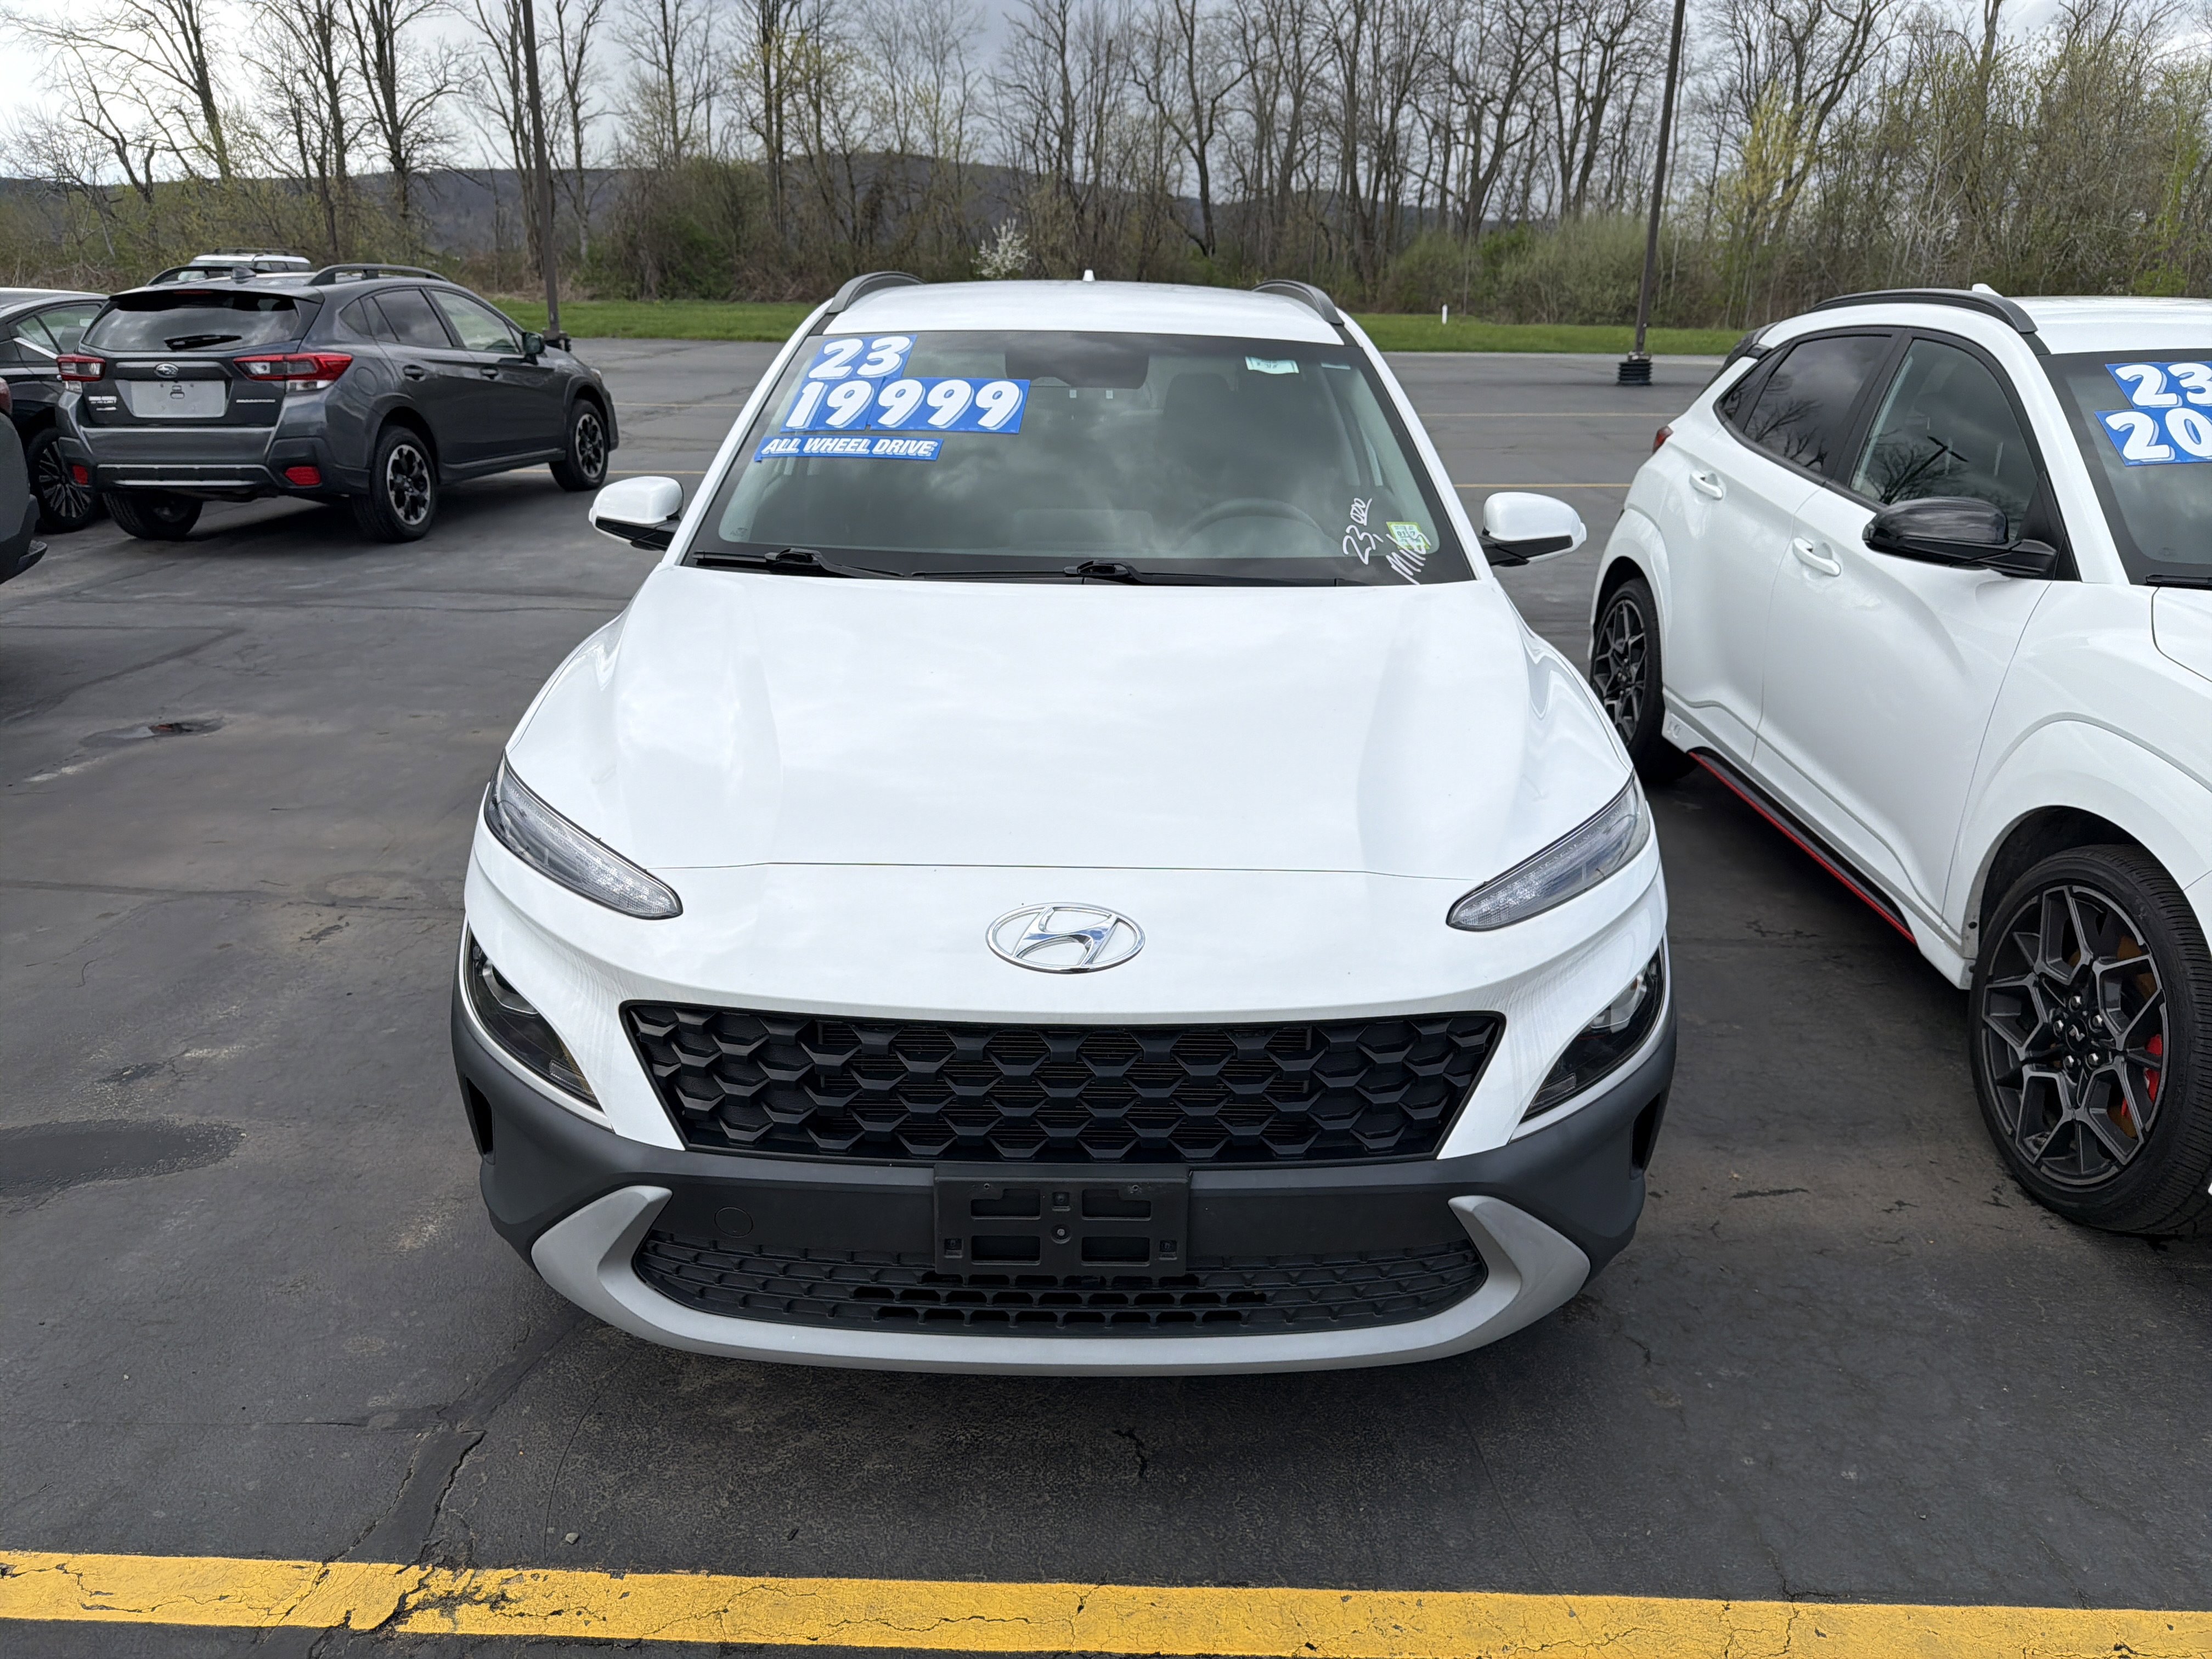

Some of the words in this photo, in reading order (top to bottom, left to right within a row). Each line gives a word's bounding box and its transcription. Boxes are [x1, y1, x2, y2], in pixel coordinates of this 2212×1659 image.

[809, 336, 913, 380] 23
[786, 379, 1024, 430] 19999
[2115, 363, 2212, 408] 23
[761, 438, 801, 454] ALL
[804, 438, 870, 454] WHEEL
[872, 439, 938, 456] DRIVE
[2105, 408, 2212, 462] 20
